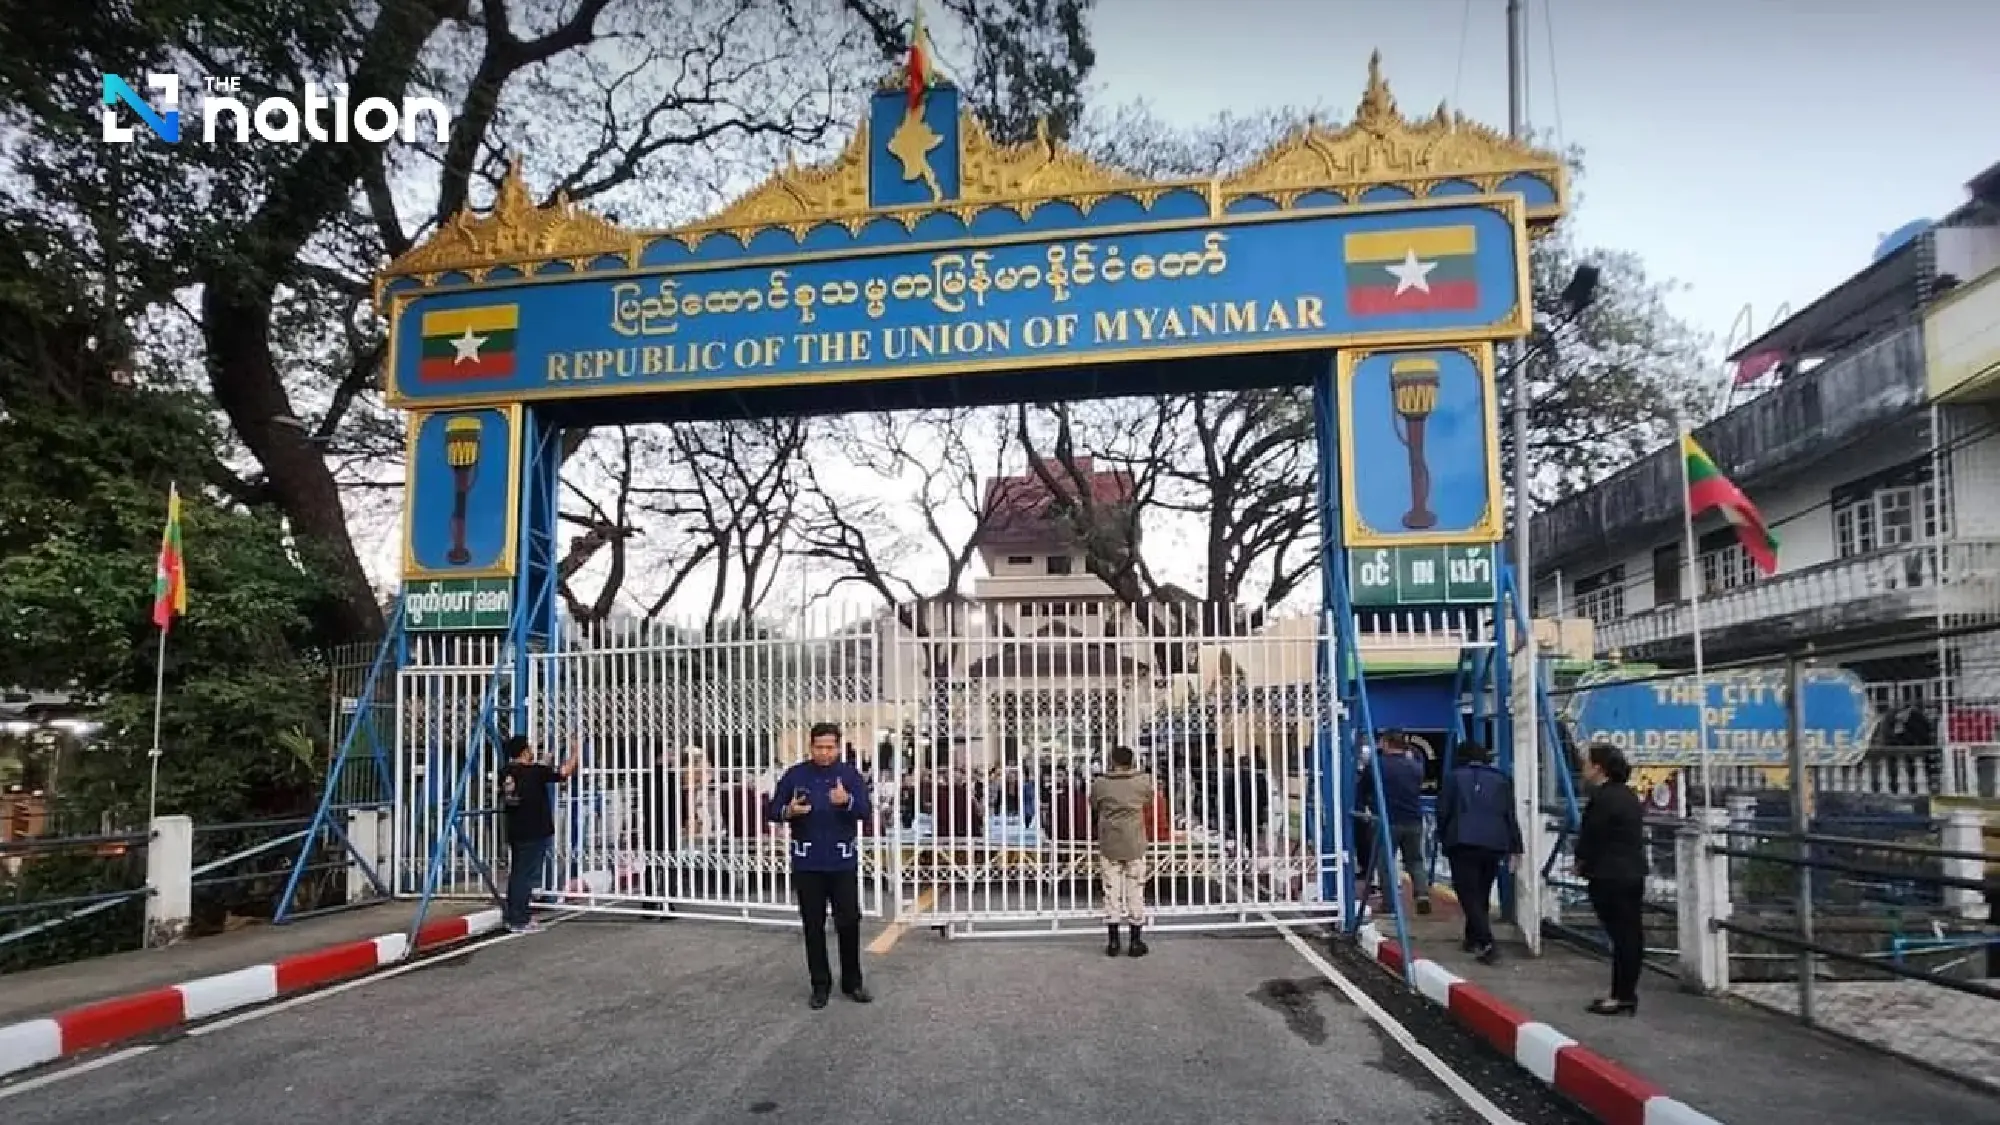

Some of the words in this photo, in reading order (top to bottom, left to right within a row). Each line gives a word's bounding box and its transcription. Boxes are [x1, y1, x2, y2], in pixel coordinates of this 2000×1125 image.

[546, 340, 726, 381] REPUBLIC
[733, 336, 784, 368] OF
[794, 329, 872, 364] THE
[883, 317, 1011, 359] UNION
[1022, 314, 1079, 349] OF
[1095, 296, 1326, 344] MYANMAR
[442, 591, 472, 611] OUT
[1652, 684, 1707, 706] THE
[1722, 684, 1789, 707] CITY
[1704, 707, 1738, 727] OF
[1592, 728, 1699, 750] GOLDEN
